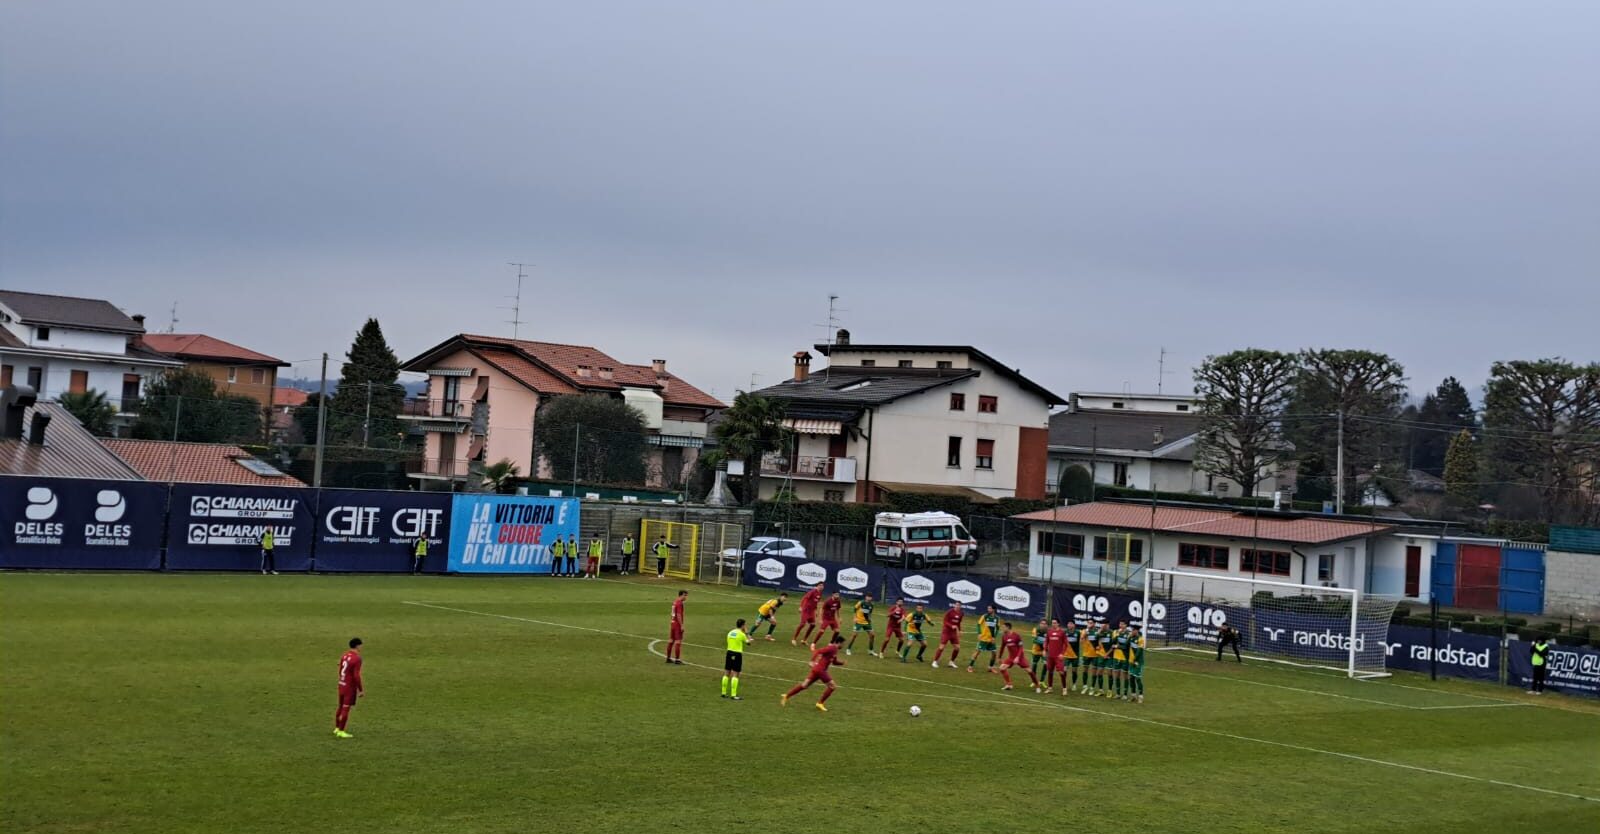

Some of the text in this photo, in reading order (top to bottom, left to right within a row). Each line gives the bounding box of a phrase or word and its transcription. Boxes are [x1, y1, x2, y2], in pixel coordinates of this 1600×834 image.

[211, 497, 294, 511] CHIARAVALLI
[471, 503, 491, 522] LA
[495, 504, 554, 524] VITTORIA
[15, 522, 63, 535] DELES
[85, 524, 131, 537] DELES
[208, 525, 292, 538] CHIARAVLLI
[467, 524, 544, 544] NEL CUORE
[462, 544, 479, 565] DI
[481, 544, 508, 565] CHI
[799, 568, 824, 578] Scoiattolo
[840, 574, 866, 583] Scoiattolo
[904, 581, 932, 592] Scoiattolo
[949, 586, 979, 598] Scoiattolo
[997, 592, 1028, 603] Scoiattolo
[1072, 593, 1110, 613] aro
[1187, 606, 1227, 628] aro
[1293, 629, 1364, 652] randstad
[1410, 643, 1489, 668] randstad
[1580, 654, 1600, 675] CL
